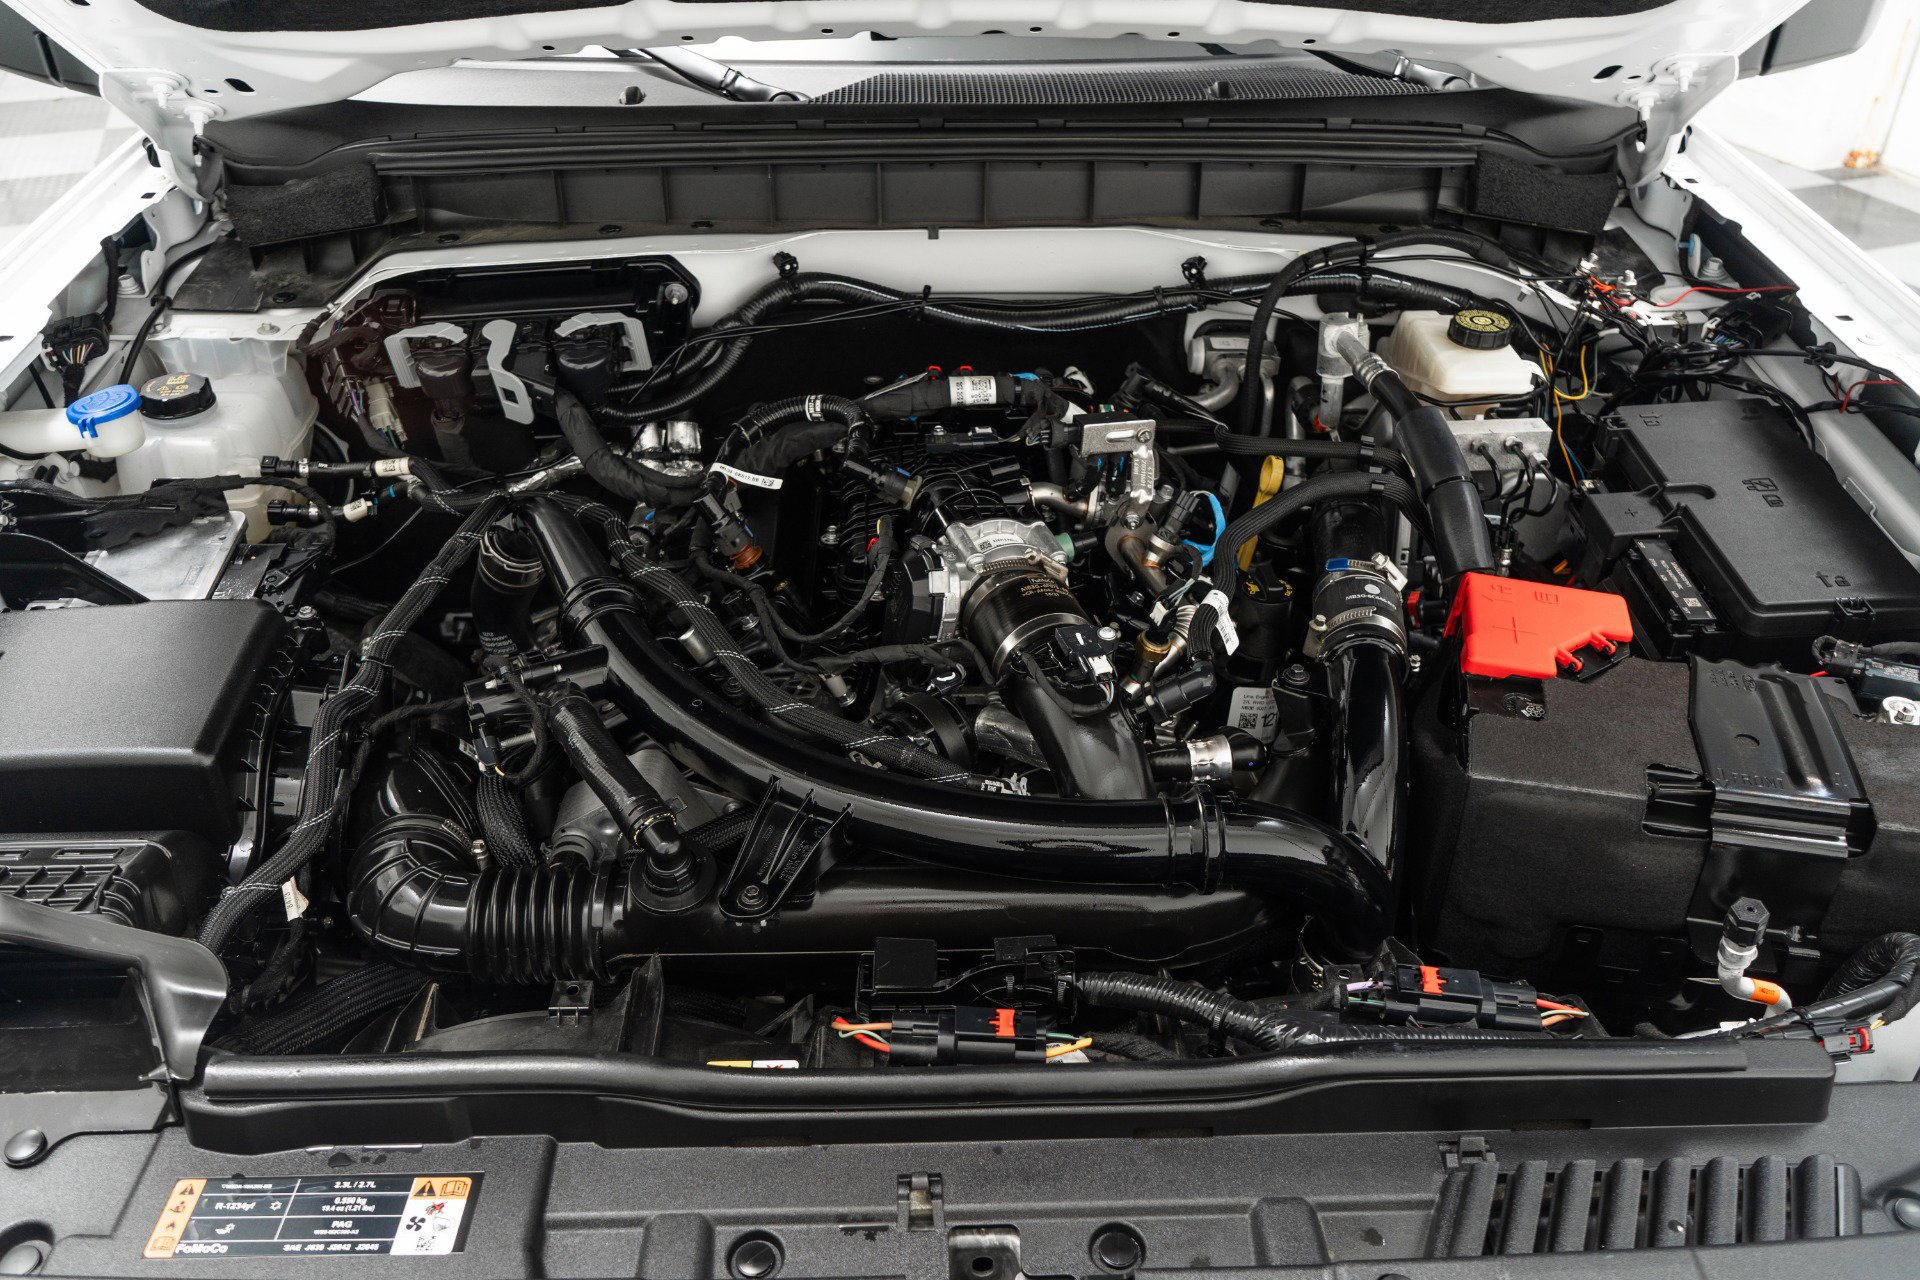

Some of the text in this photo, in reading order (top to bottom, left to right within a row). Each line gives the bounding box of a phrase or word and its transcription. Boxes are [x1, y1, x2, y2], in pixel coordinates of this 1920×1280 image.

[214, 1202, 257, 1211] R-1234yf
[331, 1220, 353, 1228] PAG
[174, 1243, 229, 1253] FoMoCo
